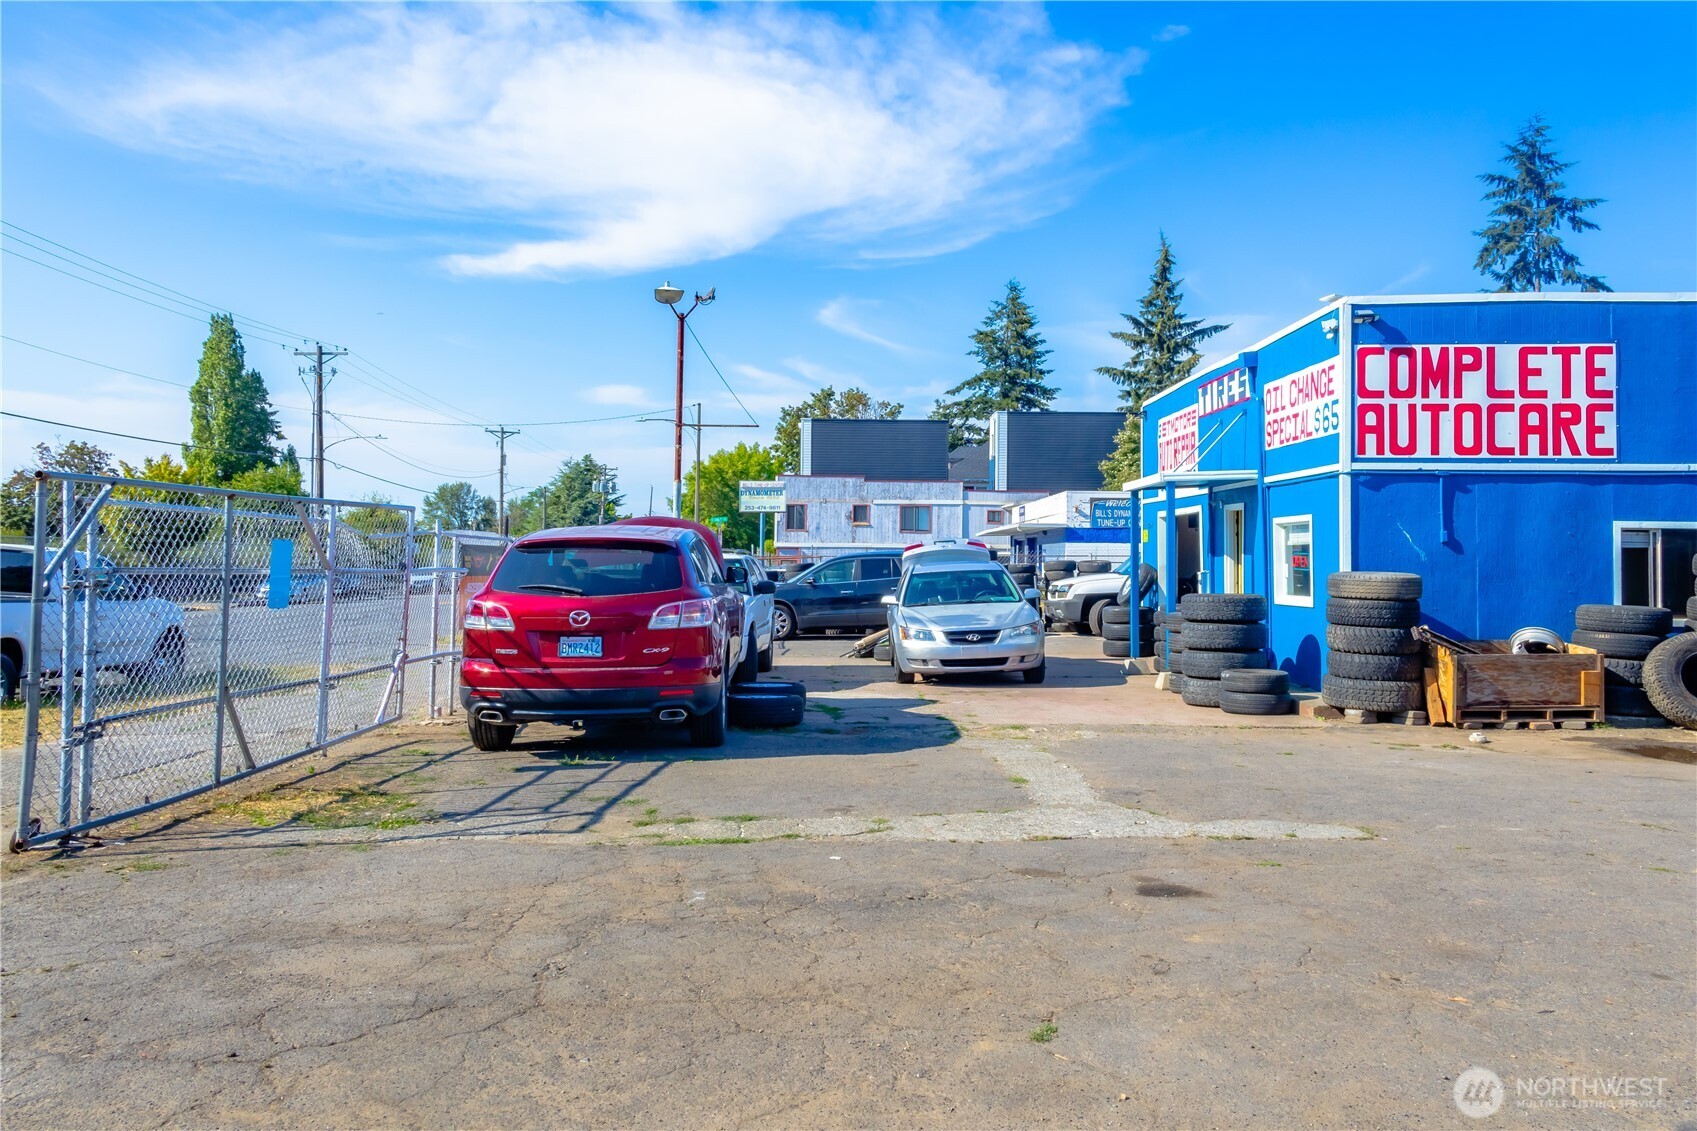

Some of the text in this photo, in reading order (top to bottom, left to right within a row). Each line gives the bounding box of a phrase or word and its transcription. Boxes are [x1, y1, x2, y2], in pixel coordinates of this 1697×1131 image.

[1201, 370, 1247, 412] TIRES
[1265, 364, 1335, 416] OIL CHANGE
[1356, 346, 1614, 399] COMPLETE
[1265, 398, 1339, 448] SPECIAL $65
[1356, 403, 1615, 456] AUTOCARE
[1095, 509, 1112, 518] BILL'S
[1097, 518, 1126, 527] TUNE-UP
[1292, 555, 1309, 568] OPEN
